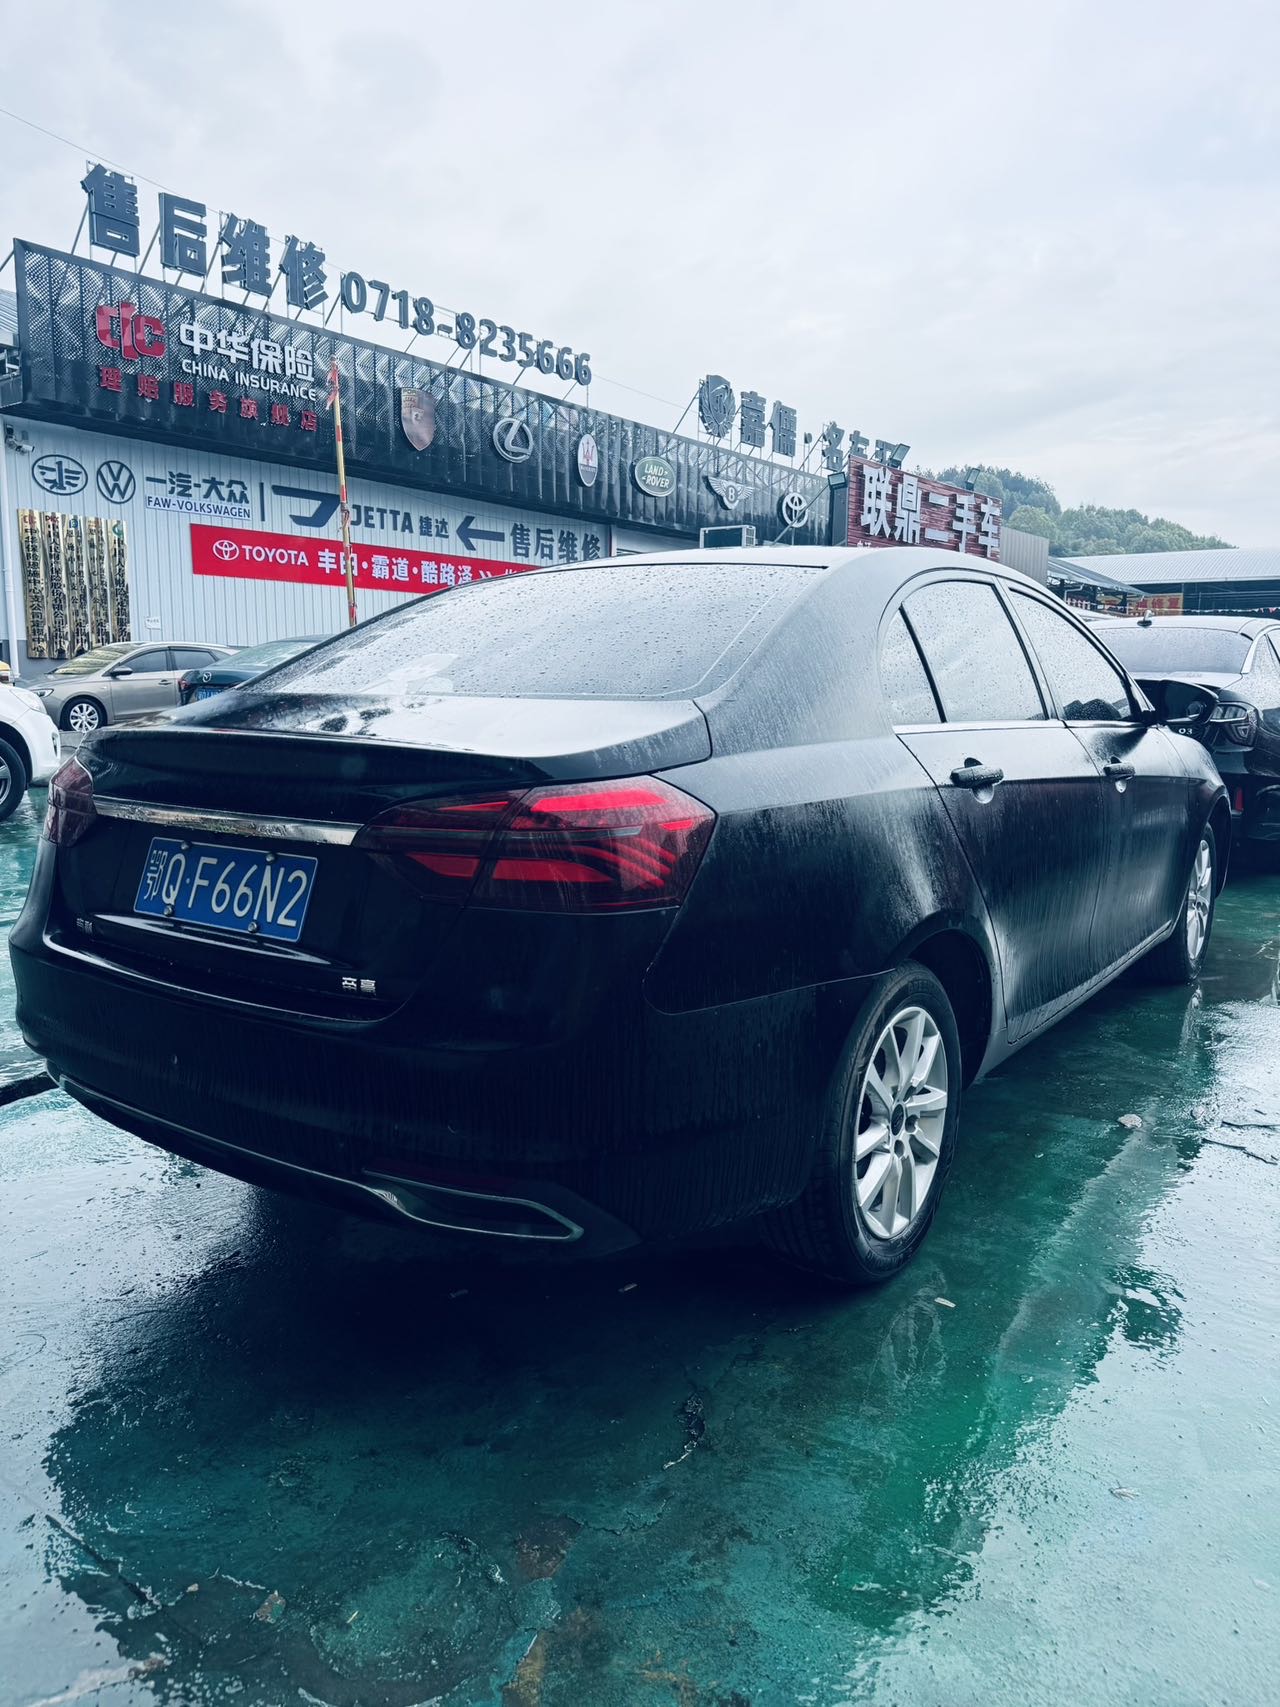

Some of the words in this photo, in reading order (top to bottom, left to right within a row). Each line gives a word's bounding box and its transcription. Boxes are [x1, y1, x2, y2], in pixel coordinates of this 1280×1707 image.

[80, 163, 329, 311] 售后维修
[341, 271, 592, 386] 0718-8235666
[179, 321, 315, 382] 中华保险
[100, 367, 318, 432] 理赔服务旗舰店
[182, 358, 229, 382] CHINA
[235, 370, 317, 401] INSURANCE
[145, 471, 250, 504] 一汽-大众
[644, 463, 665, 478] LAND
[646, 475, 671, 490] ROVER
[147, 496, 251, 519] FAW-VOLKSWAGEN
[350, 504, 414, 534] JETTA
[419, 515, 450, 539] 捷达
[861, 464, 1001, 558] 联鼎二手车
[241, 544, 309, 567] TOYOTA
[510, 522, 601, 562] 售后维修
[144, 849, 308, 928] 鄂Q·F66N2
